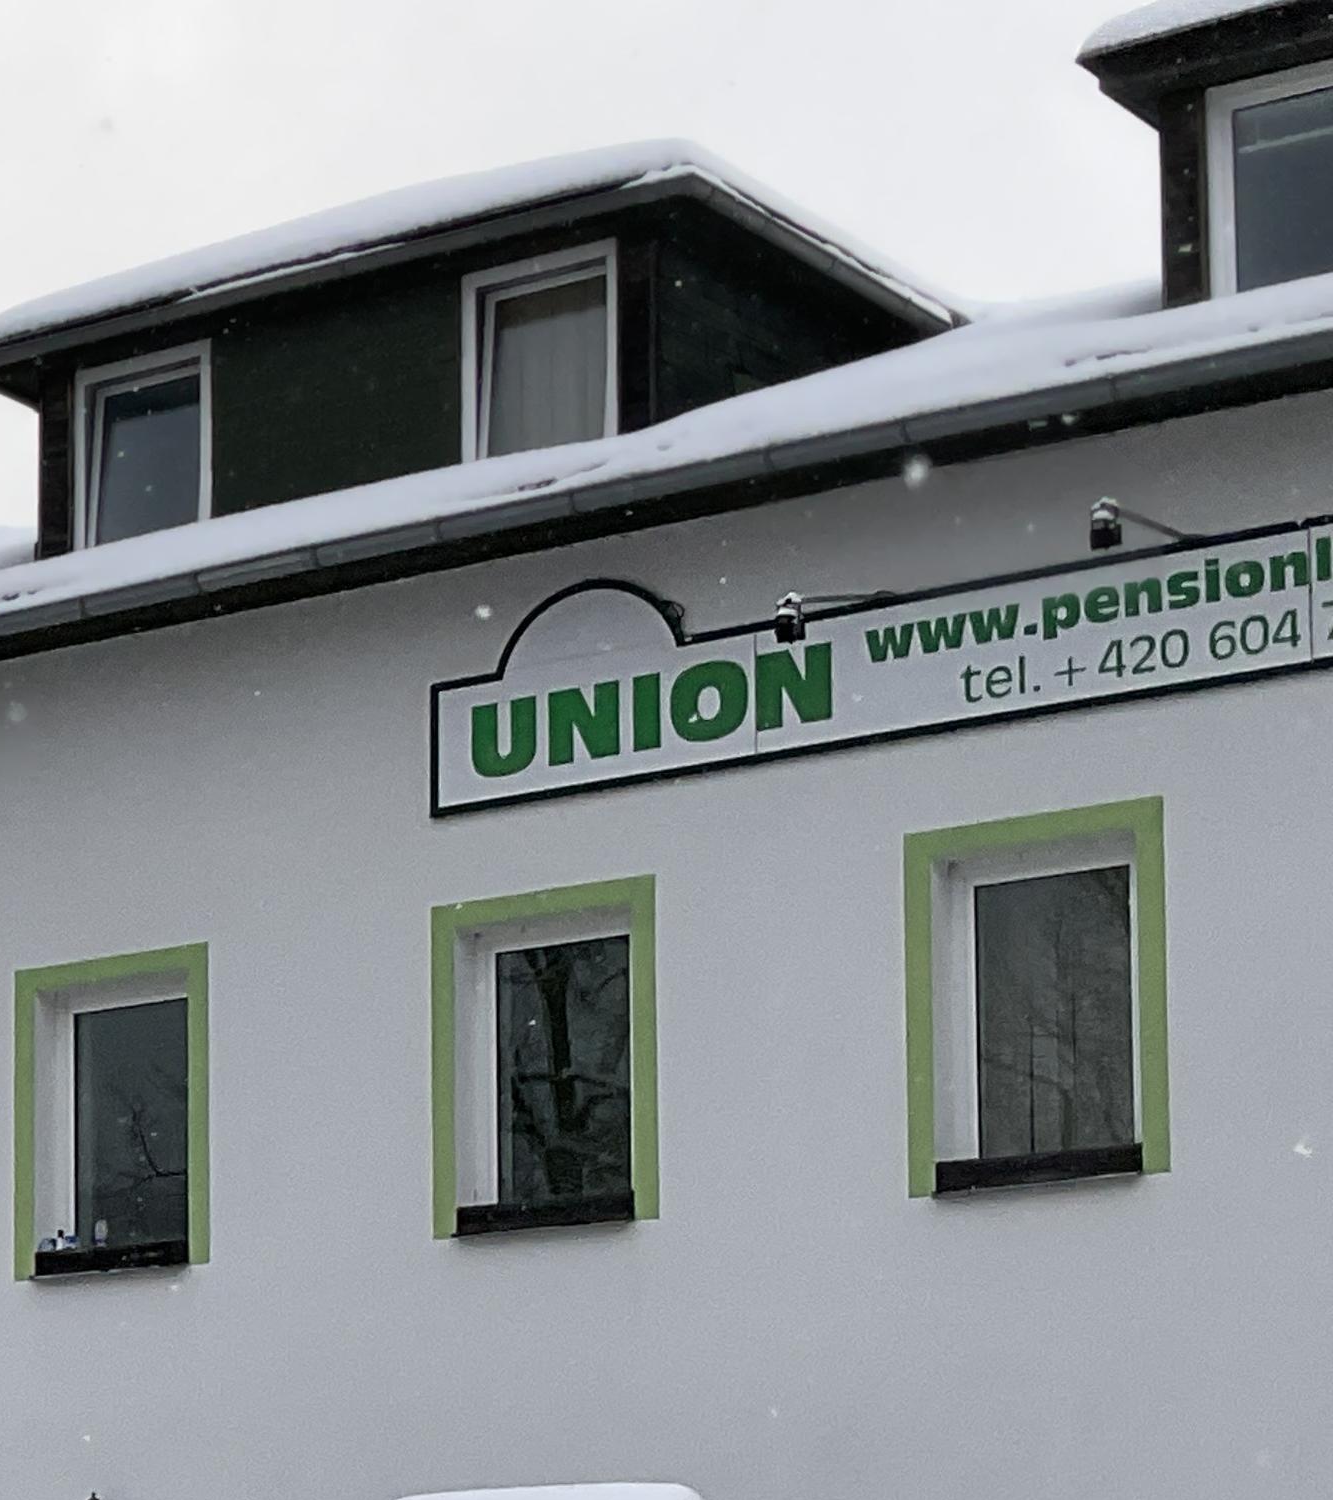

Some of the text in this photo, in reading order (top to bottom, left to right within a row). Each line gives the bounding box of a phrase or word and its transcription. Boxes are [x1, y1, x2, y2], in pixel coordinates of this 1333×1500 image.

[471, 641, 832, 778] UNION
[961, 655, 1041, 703] tel.
[1208, 608, 1301, 661] 604
